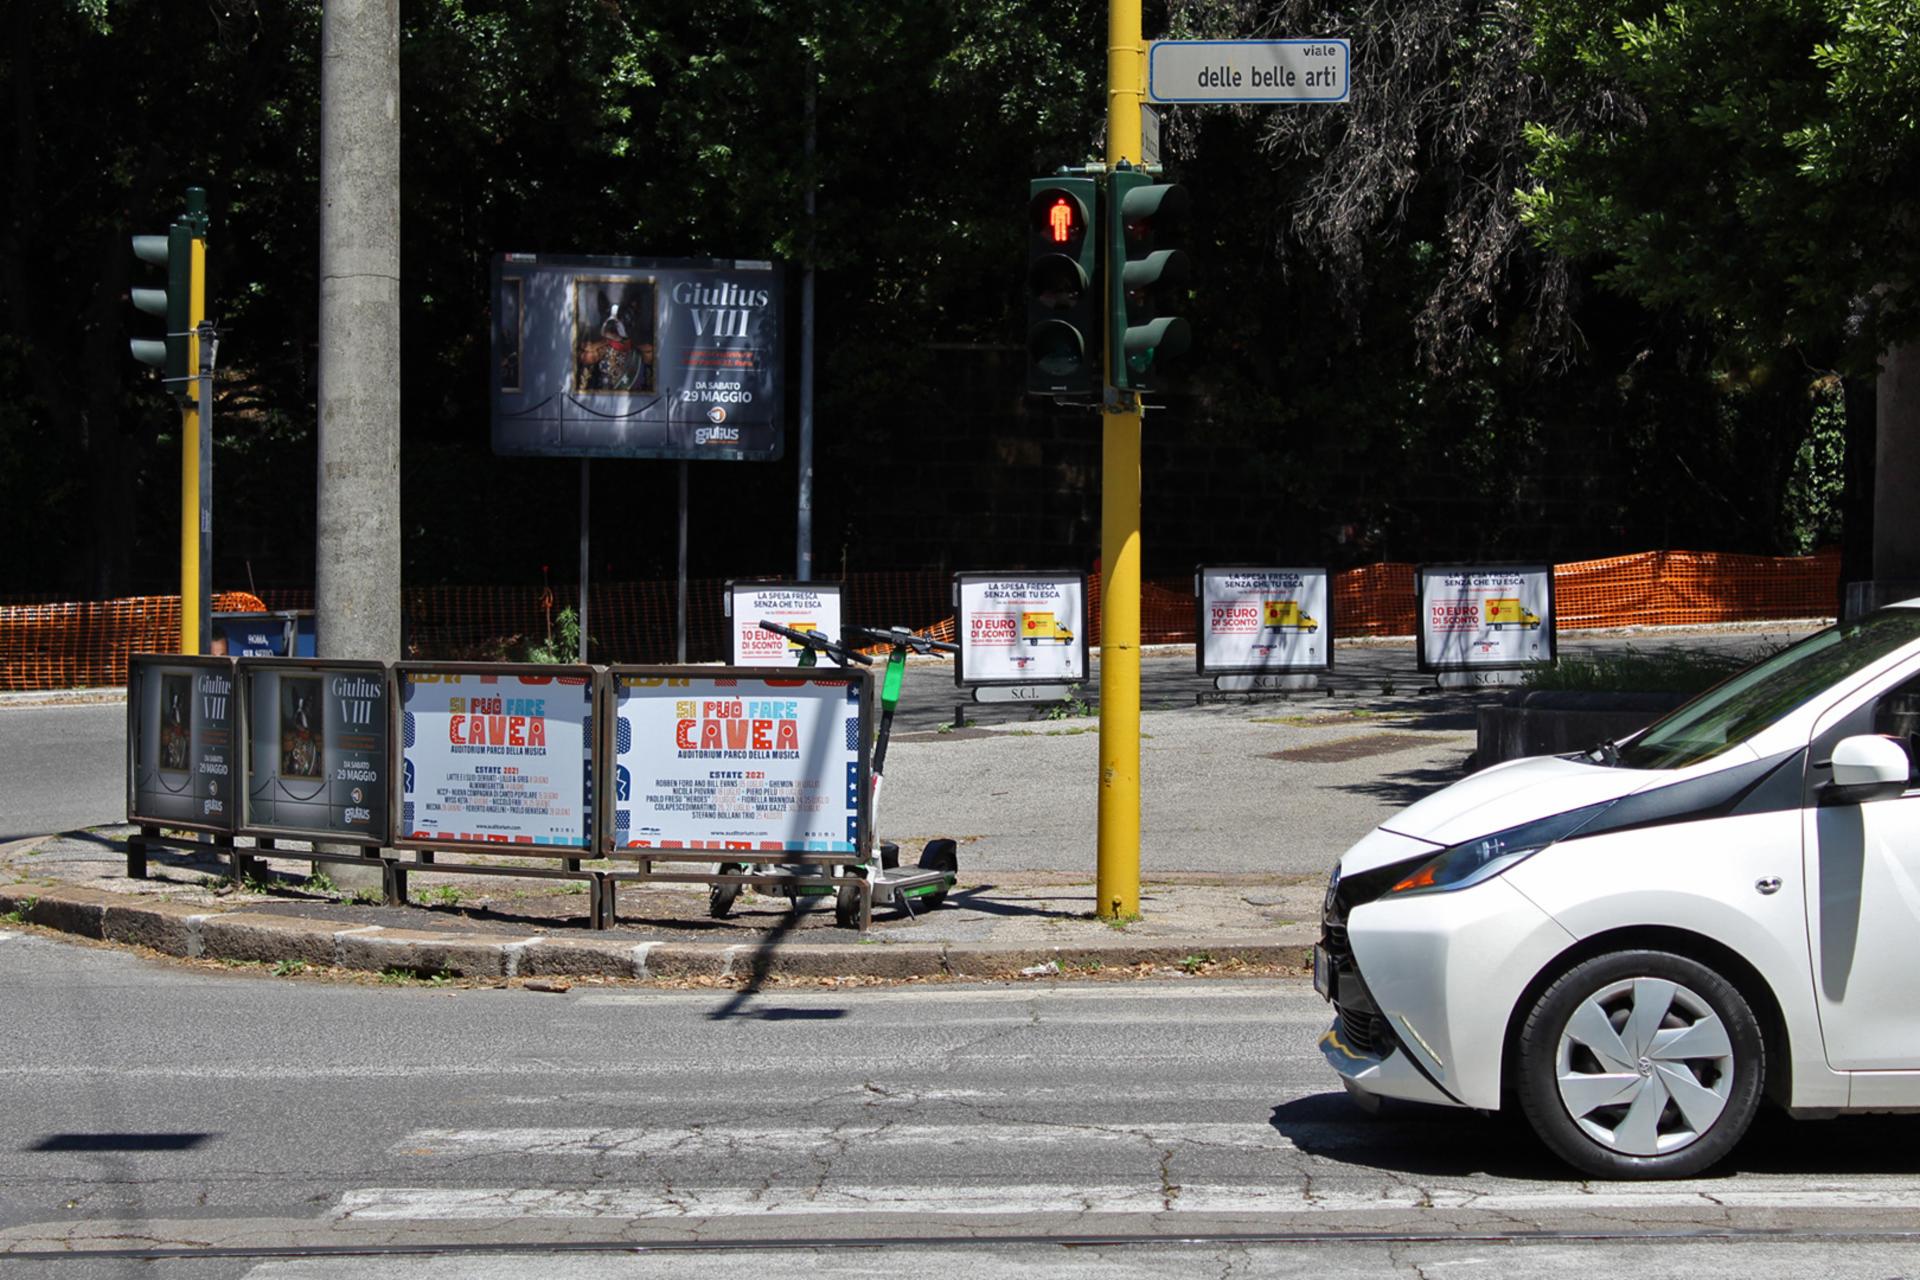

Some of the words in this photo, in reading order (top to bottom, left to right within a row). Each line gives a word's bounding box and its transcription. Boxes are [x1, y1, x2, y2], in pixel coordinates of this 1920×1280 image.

[1303, 45, 1336, 56] viale
[1198, 66, 1242, 87] delle
[1251, 66, 1296, 87] belle
[1305, 66, 1336, 87] arti
[672, 281, 768, 308] Giulius
[691, 309, 750, 338] VIII
[696, 382, 707, 390] DA
[708, 382, 741, 390] SABATO
[683, 391, 698, 402] 29
[702, 391, 752, 403] MAGGIO
[695, 426, 739, 445] giulius
[1026, 582, 1056, 590] FRESCA
[1225, 580, 1251, 588] SENZA
[1271, 580, 1282, 588] TU
[1283, 580, 1304, 588] ESCA
[1444, 578, 1472, 586] SENZA
[1473, 578, 1490, 586] CHE
[1491, 578, 1502, 586] TU
[1503, 578, 1525, 586] ESCA
[757, 592, 768, 600] LA
[769, 592, 791, 600] SPESA
[792, 592, 819, 600] FRESCA
[984, 591, 1010, 599] SENZA
[1011, 591, 1027, 599] CHE
[1029, 591, 1039, 599] TU
[1040, 591, 1060, 599] ESCA
[1212, 608, 1224, 618] 10
[1226, 608, 1258, 618] EURO
[1432, 606, 1446, 616] 10
[1447, 606, 1479, 616] EURO
[971, 619, 984, 630] 10
[985, 619, 1016, 630] EURO
[1212, 618, 1222, 626] DI
[1223, 618, 1258, 626] SCONTO
[1432, 616, 1441, 625] DI
[1443, 616, 1479, 625] SCONTO
[742, 630, 754, 641] 10
[755, 630, 783, 641] EURO
[971, 630, 980, 638] DI
[981, 630, 1016, 638] SCONTO
[742, 641, 751, 650] DI
[752, 641, 783, 650] SCONTO
[333, 677, 381, 698] Giulius
[204, 696, 227, 720] VIII
[341, 700, 371, 724] VIII
[449, 697, 466, 714] SI
[506, 698, 545, 717] FARE
[676, 701, 696, 718] SI
[749, 701, 797, 718] FARE
[450, 715, 545, 746] CAVEA
[676, 719, 799, 750] CAVEA
[451, 745, 485, 754] AUDITORIUM
[487, 746, 505, 755] PARCO
[506, 746, 523, 755] DELLA
[525, 747, 546, 756] MUSICA
[678, 750, 722, 759] AUDITORIUM
[724, 751, 747, 759] PARCO
[749, 751, 770, 759] DELLA
[772, 751, 799, 760] MUSICA
[337, 769, 346, 780] 29
[347, 770, 376, 782] MAGGIO
[475, 766, 501, 774] ESTATE
[503, 767, 519, 775] 2021
[709, 771, 743, 779] ESTATE
[745, 771, 765, 779] 2021
[656, 779, 678, 787] ROBBEN
[673, 787, 692, 795] NICOLA
[646, 795, 664, 803] PAOLO
[665, 795, 682, 803] FRESU
[769, 796, 795, 804] MANNOIA
[692, 811, 716, 819] STEFANO
[717, 811, 741, 819] BOLLANI
[742, 811, 755, 820] TRIO
